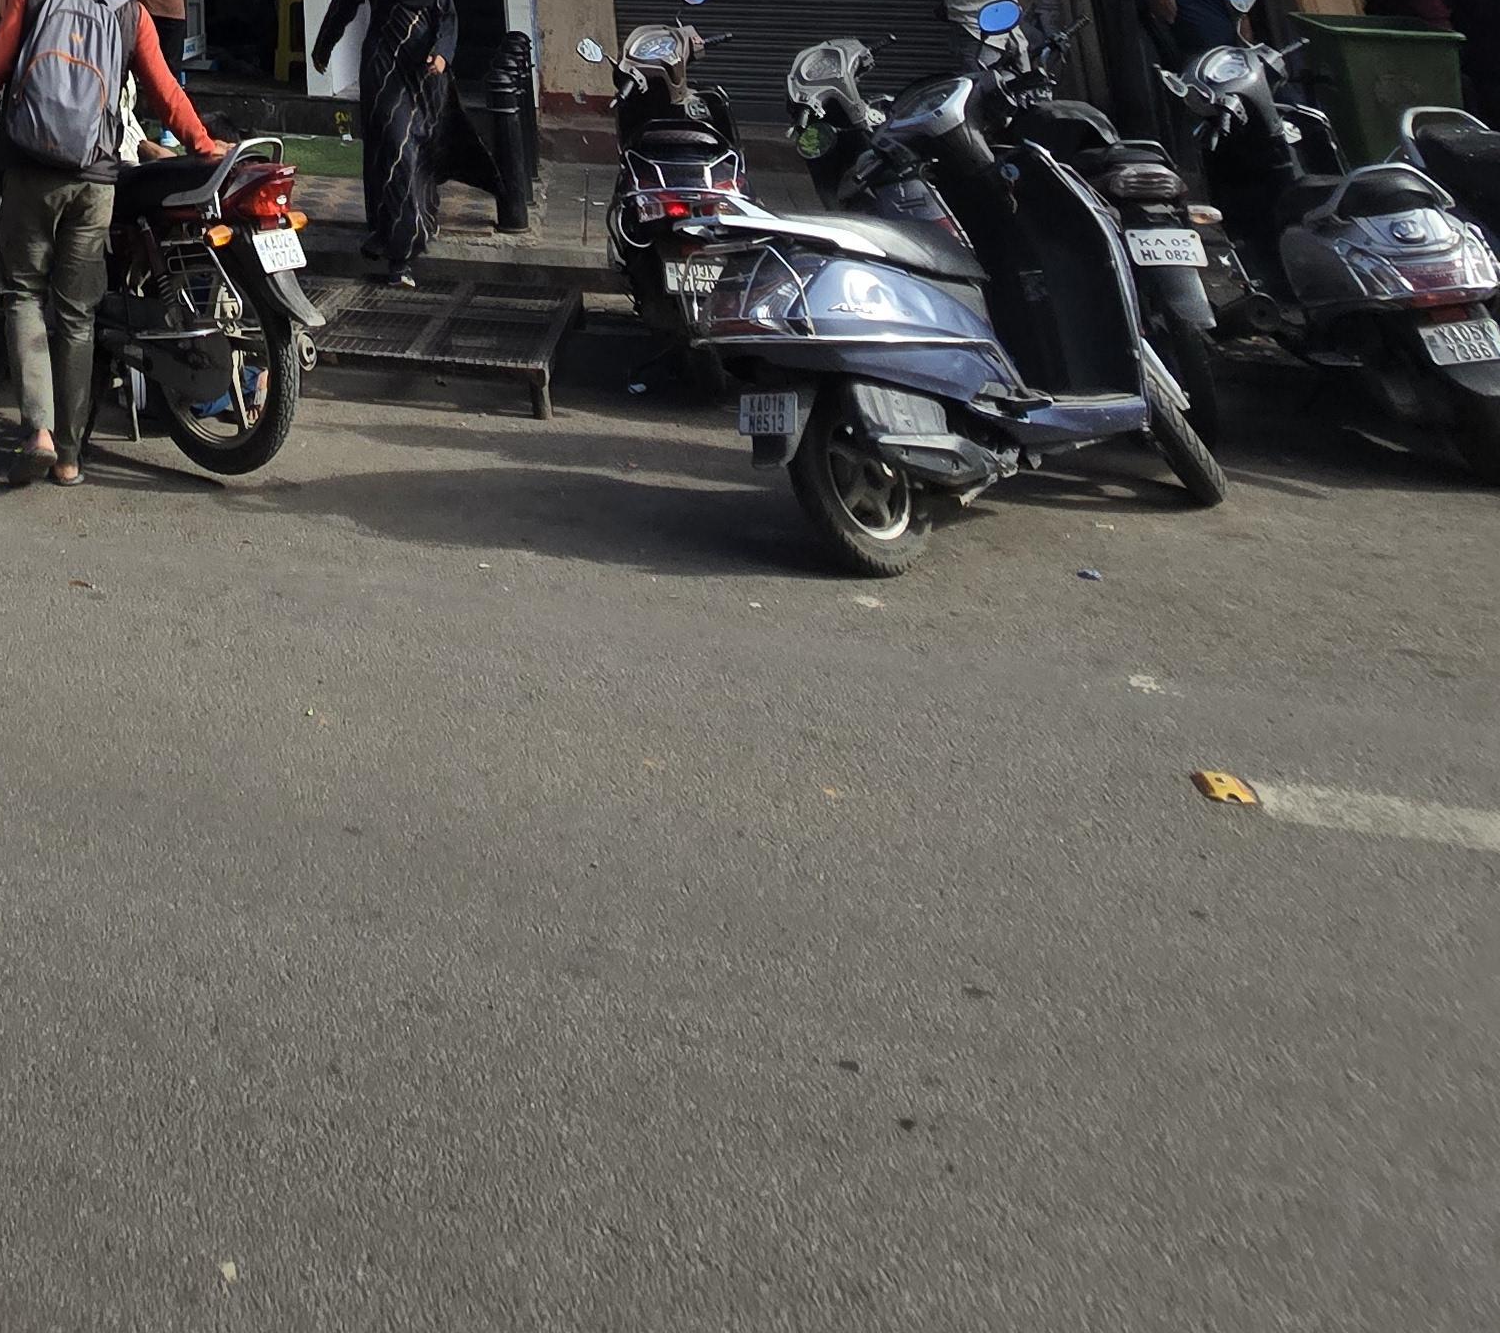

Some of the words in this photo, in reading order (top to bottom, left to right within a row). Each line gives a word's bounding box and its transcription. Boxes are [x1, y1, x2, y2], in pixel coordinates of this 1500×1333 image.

[1138, 238, 1166, 246] KA
[1171, 238, 1191, 246] 05
[1140, 249, 1161, 261] HL
[1165, 249, 1199, 262] 0821
[750, 395, 785, 412] KA01H
